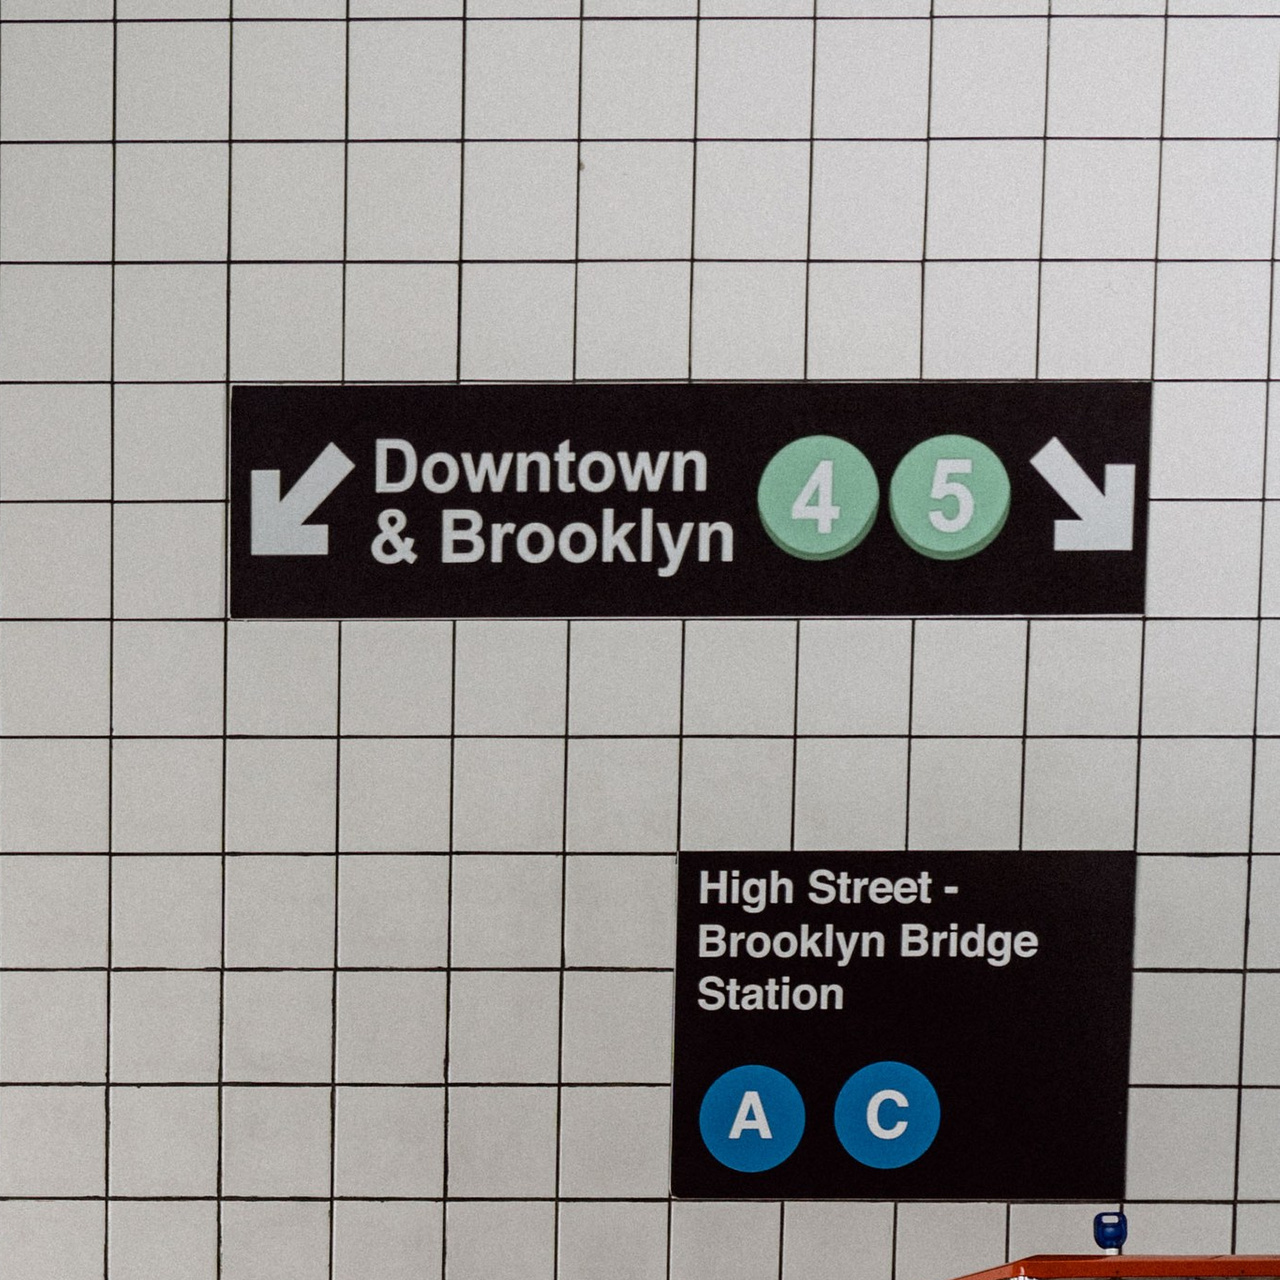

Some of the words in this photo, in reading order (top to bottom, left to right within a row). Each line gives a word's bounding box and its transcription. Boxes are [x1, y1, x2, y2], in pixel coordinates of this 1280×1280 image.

[375, 438, 708, 494] Downtown
[791, 460, 840, 534] 4
[928, 458, 975, 533] 5
[371, 508, 418, 565] &
[441, 507, 734, 578] Brooklyn
[700, 869, 794, 914] High
[808, 869, 933, 905] Street
[698, 923, 885, 967] Brooklyn
[900, 922, 1039, 967] Bridge
[697, 975, 844, 1011] Station
[728, 1090, 773, 1140] A
[866, 1089, 910, 1140] C
